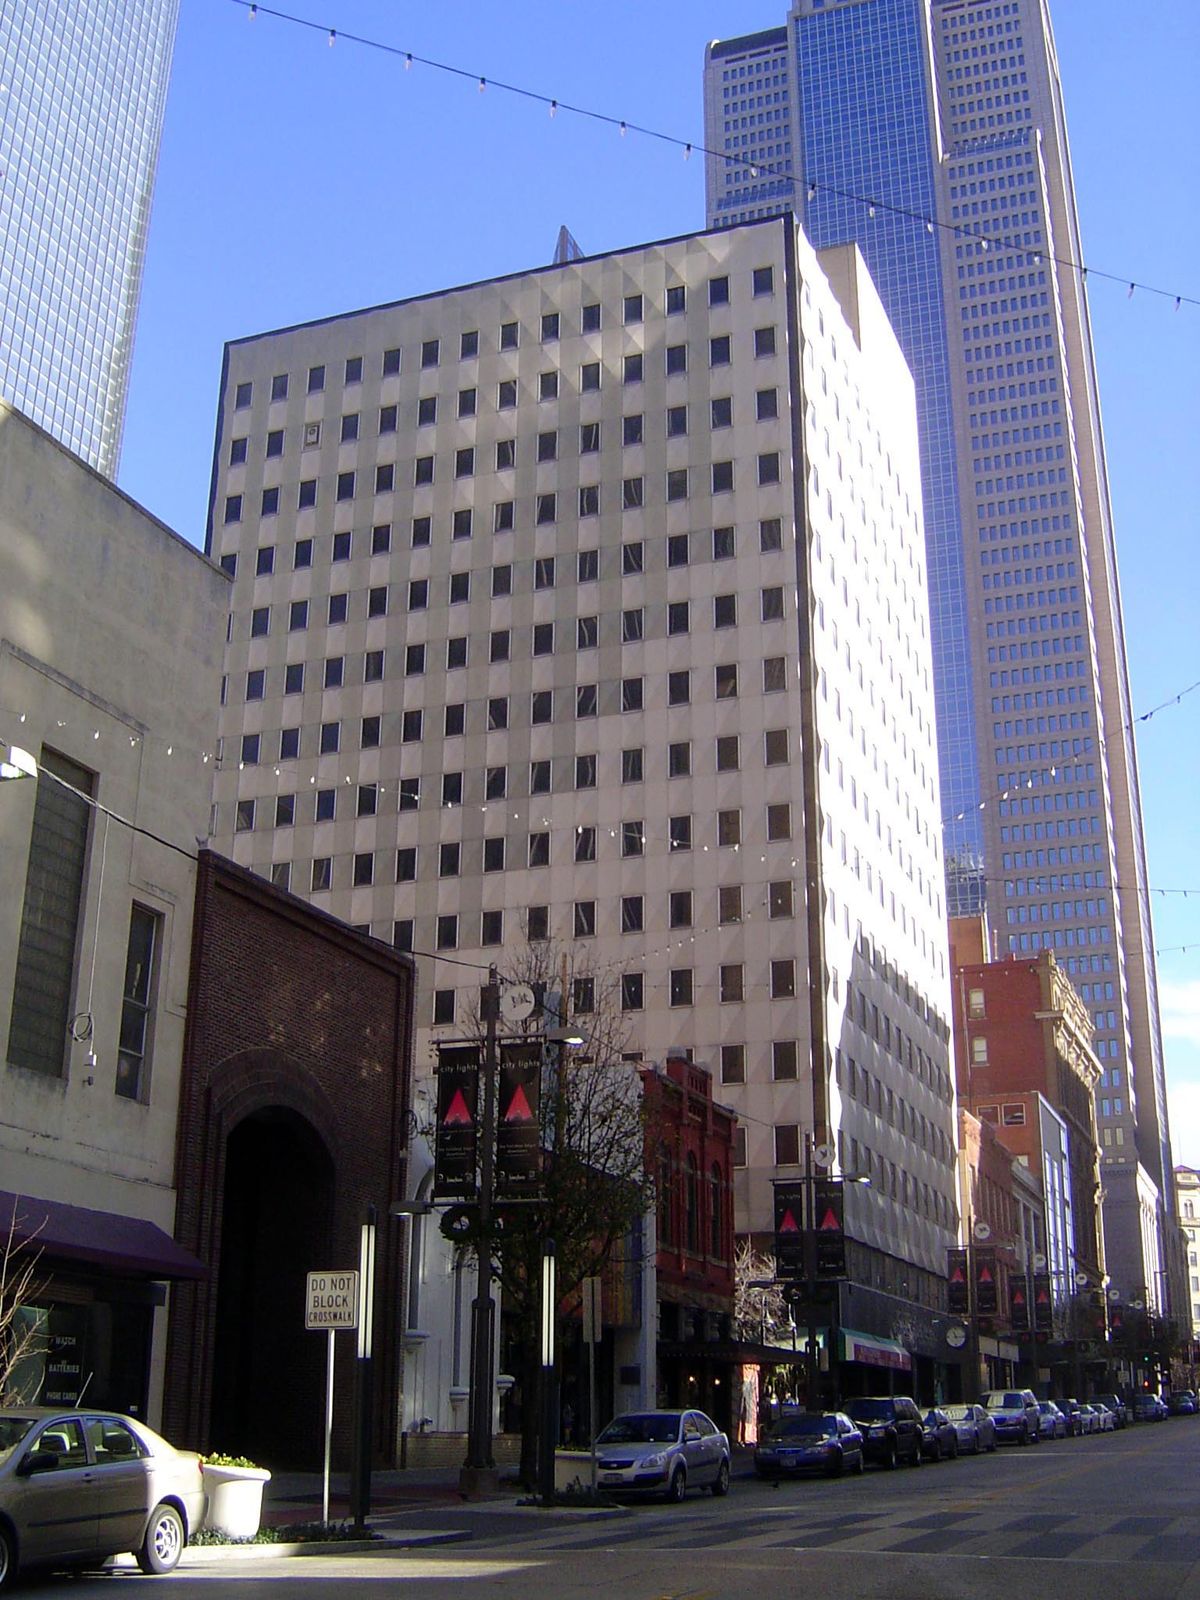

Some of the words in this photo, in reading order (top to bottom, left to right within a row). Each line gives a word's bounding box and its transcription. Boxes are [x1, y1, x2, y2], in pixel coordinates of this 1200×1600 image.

[311, 1278, 326, 1291] DO
[330, 1277, 352, 1291] NOT
[312, 1295, 349, 1308] BLOCK
[308, 1311, 353, 1322] CROSSWALK
[55, 1336, 77, 1345] WATCH
[48, 1364, 80, 1374] BATTERIES
